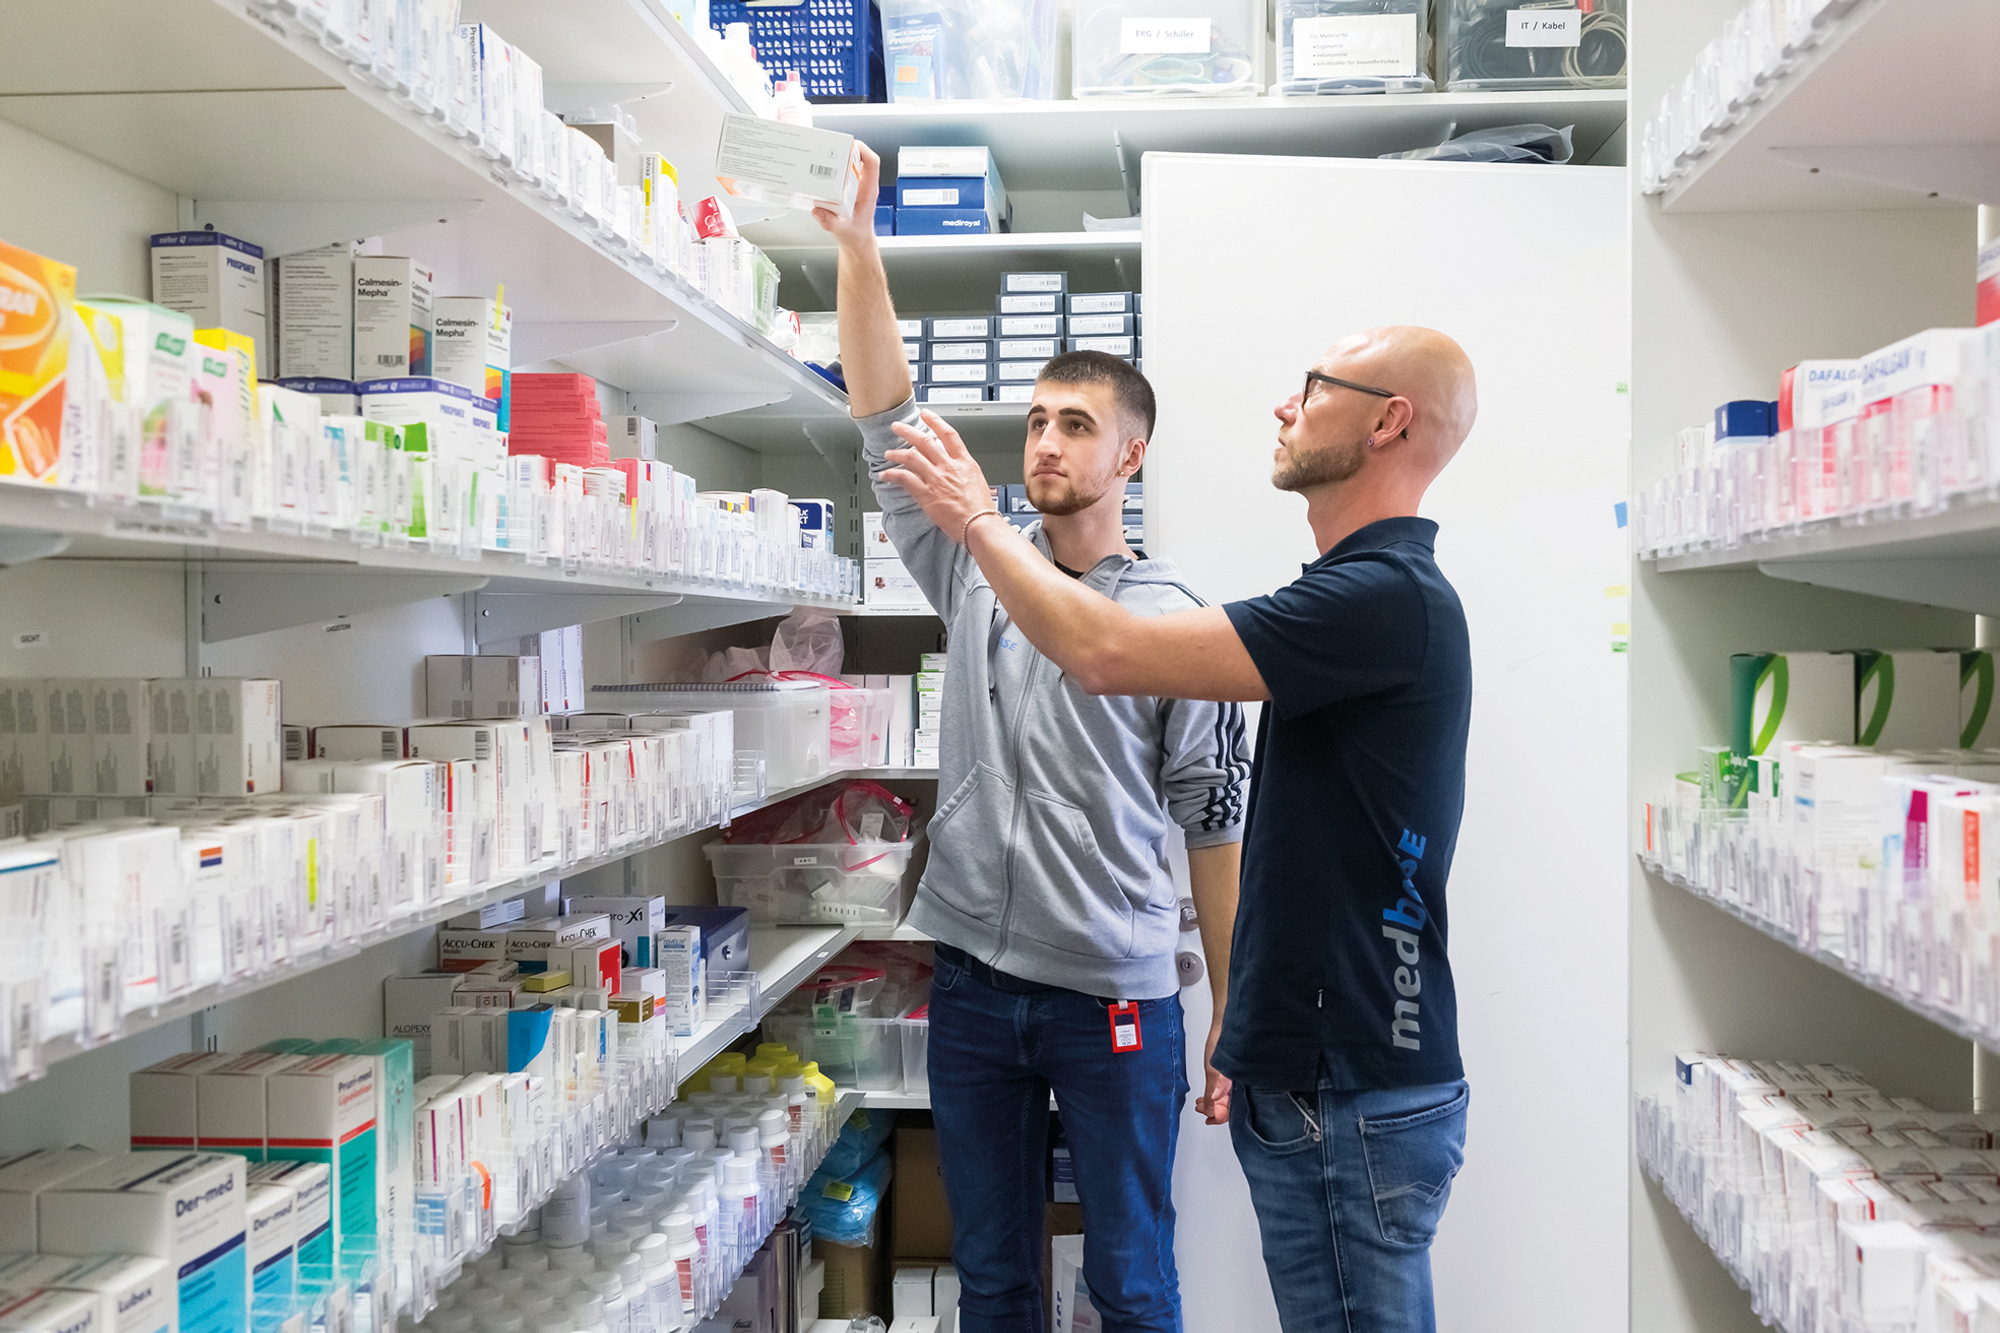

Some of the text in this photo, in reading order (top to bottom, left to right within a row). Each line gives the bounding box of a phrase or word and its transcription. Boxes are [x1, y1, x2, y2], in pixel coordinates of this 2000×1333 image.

[1521, 21, 1530, 30] IT
[1542, 21, 1566, 30] Kabel
[1135, 30, 1152, 38] EKG
[1164, 30, 1194, 38] Schiller
[1356, 58, 1400, 66] Gesundheitscheck
[942, 219, 981, 228] mediroyal
[357, 277, 403, 287] Calmesin-
[357, 288, 391, 298] Mepha
[435, 318, 479, 327] Calmesin-
[435, 328, 467, 338] Mepha
[368, 381, 427, 392] zeller medical
[442, 938, 498, 949] ACCU-CHEK
[510, 939, 552, 949] ACCU-CHEK
[392, 1024, 431, 1033] ALOPEXY
[175, 1171, 235, 1218] Der-med
[252, 1199, 293, 1232] Der-med
[117, 1287, 152, 1314] Lubex
